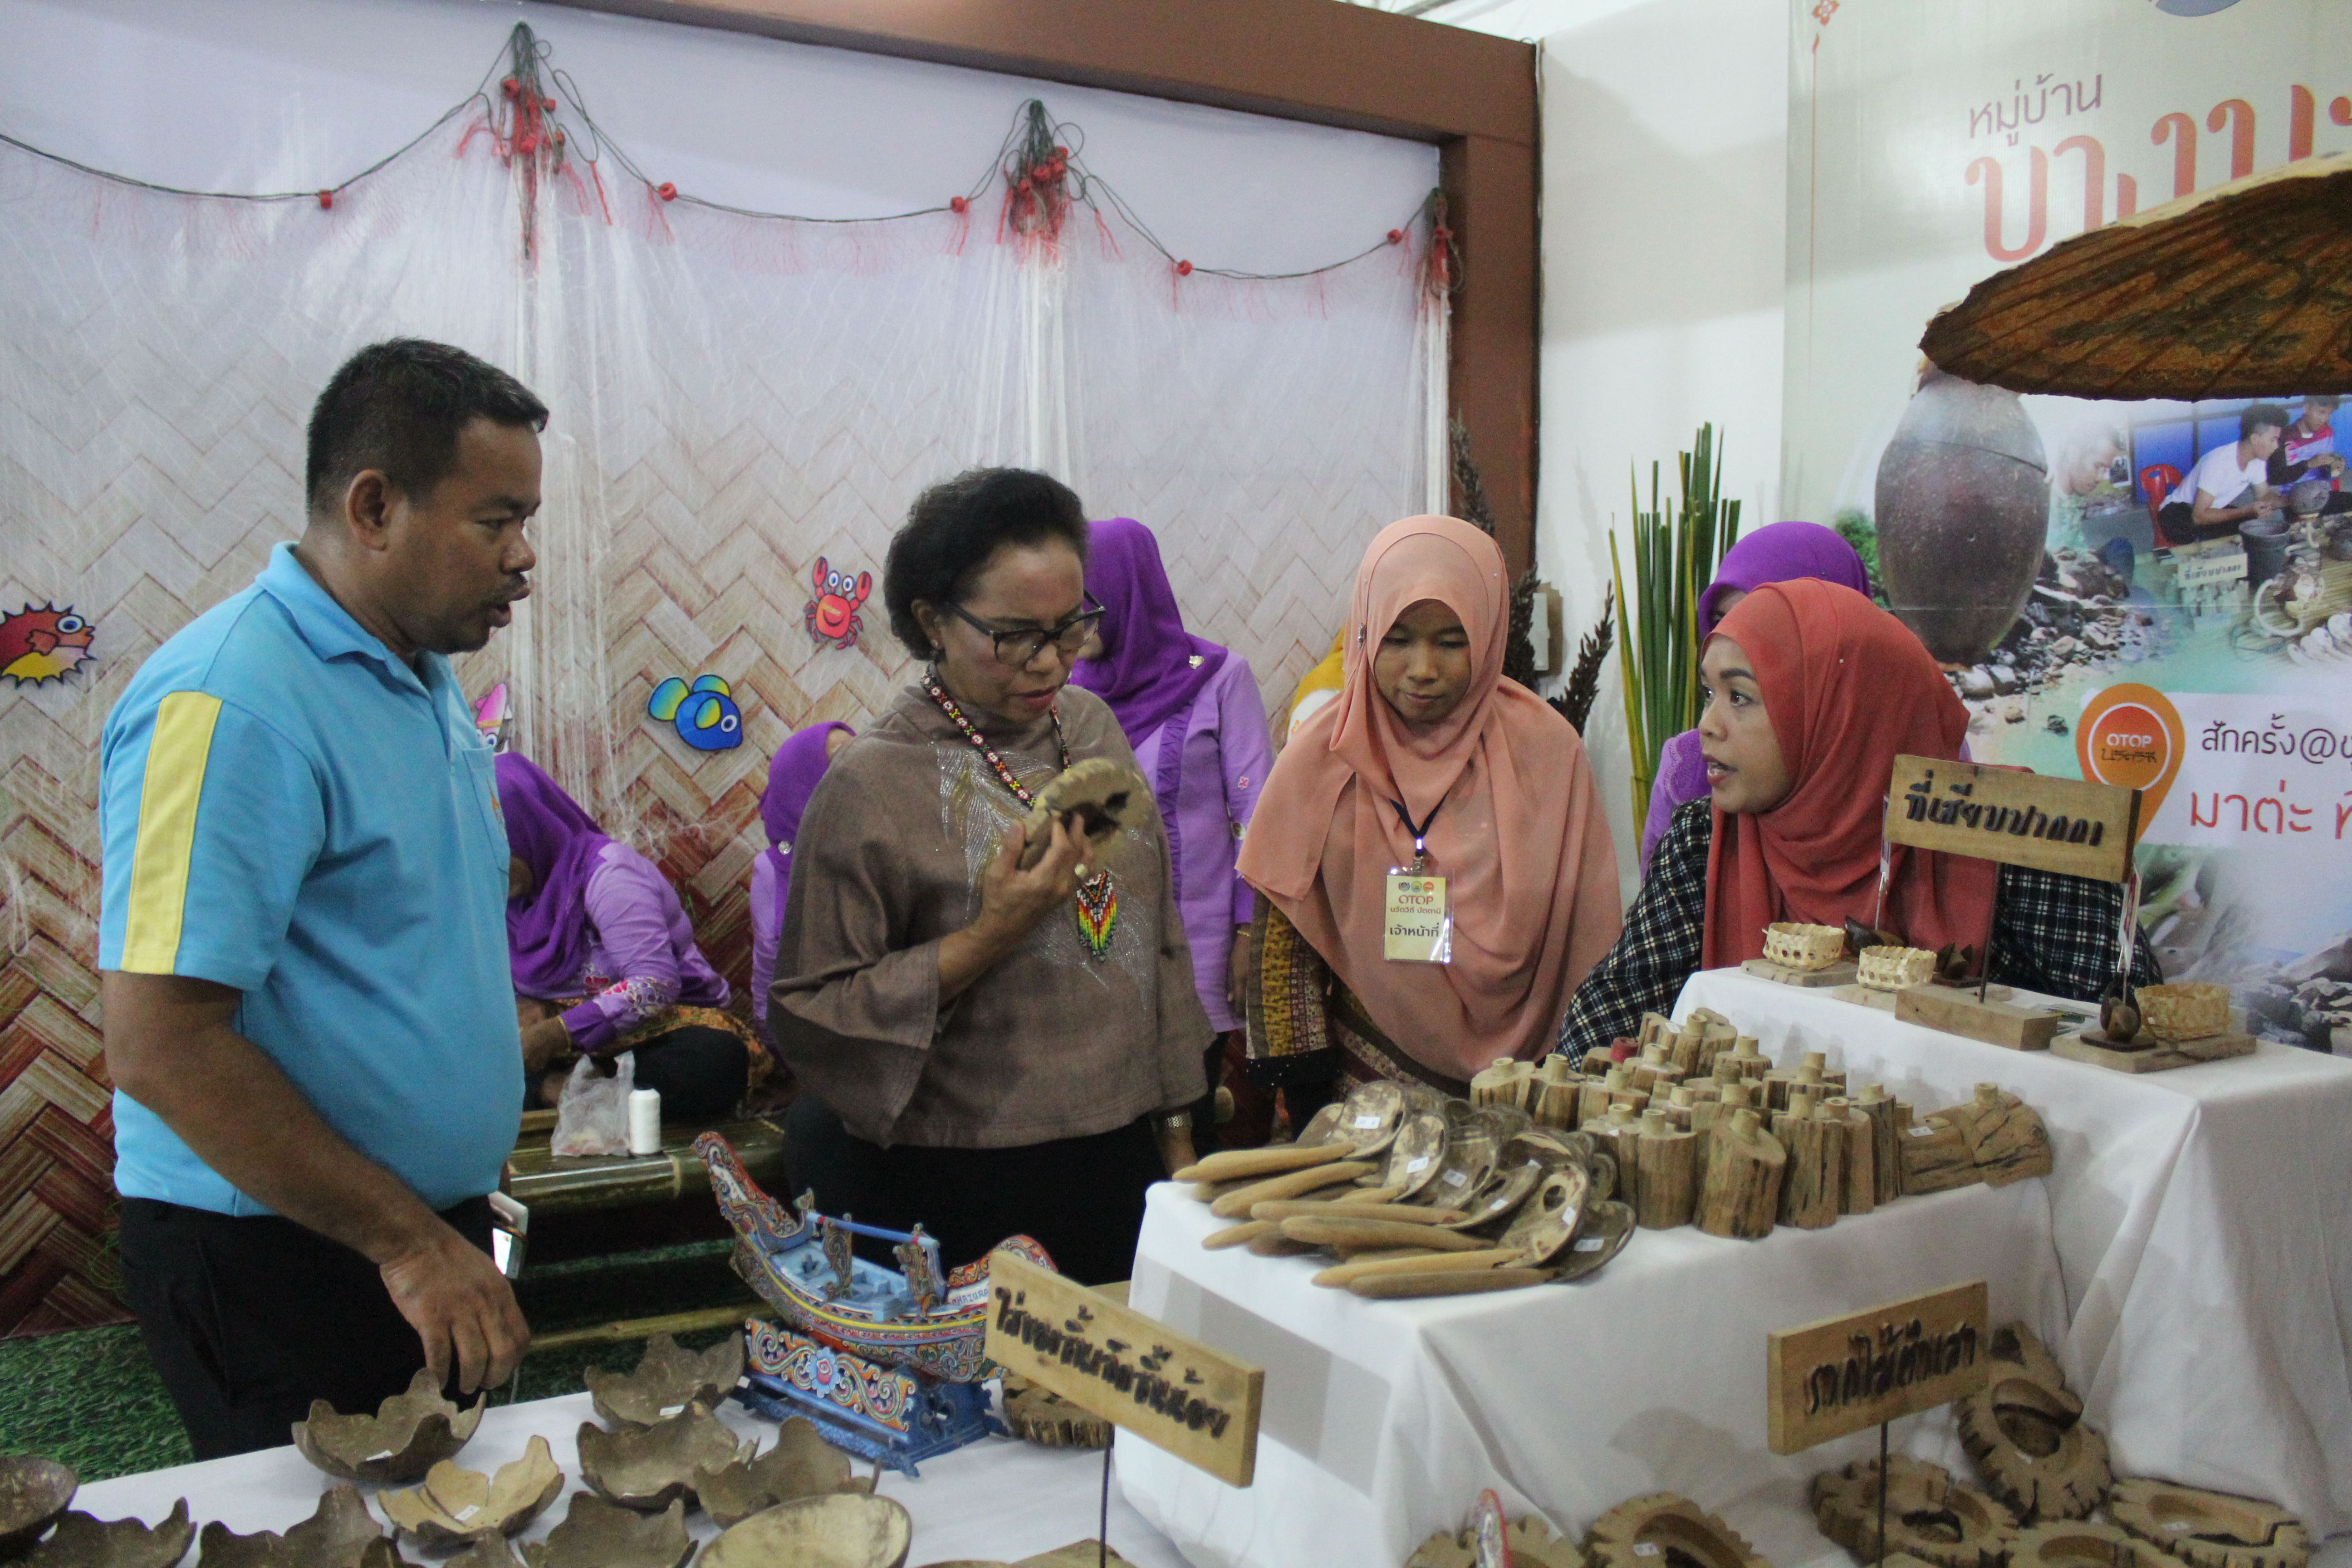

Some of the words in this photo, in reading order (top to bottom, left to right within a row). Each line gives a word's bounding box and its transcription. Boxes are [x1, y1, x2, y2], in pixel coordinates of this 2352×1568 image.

[1969, 73, 2103, 148] หมู่บ้าน
[2106, 733, 2152, 748] OTOP
[1905, 769, 2104, 847] ที่เสียบปากกา
[2190, 779, 2313, 834] มาต่ะ
[1398, 895, 1434, 905] OTOP
[1390, 922, 1439, 937] เจ้าหน้าที่
